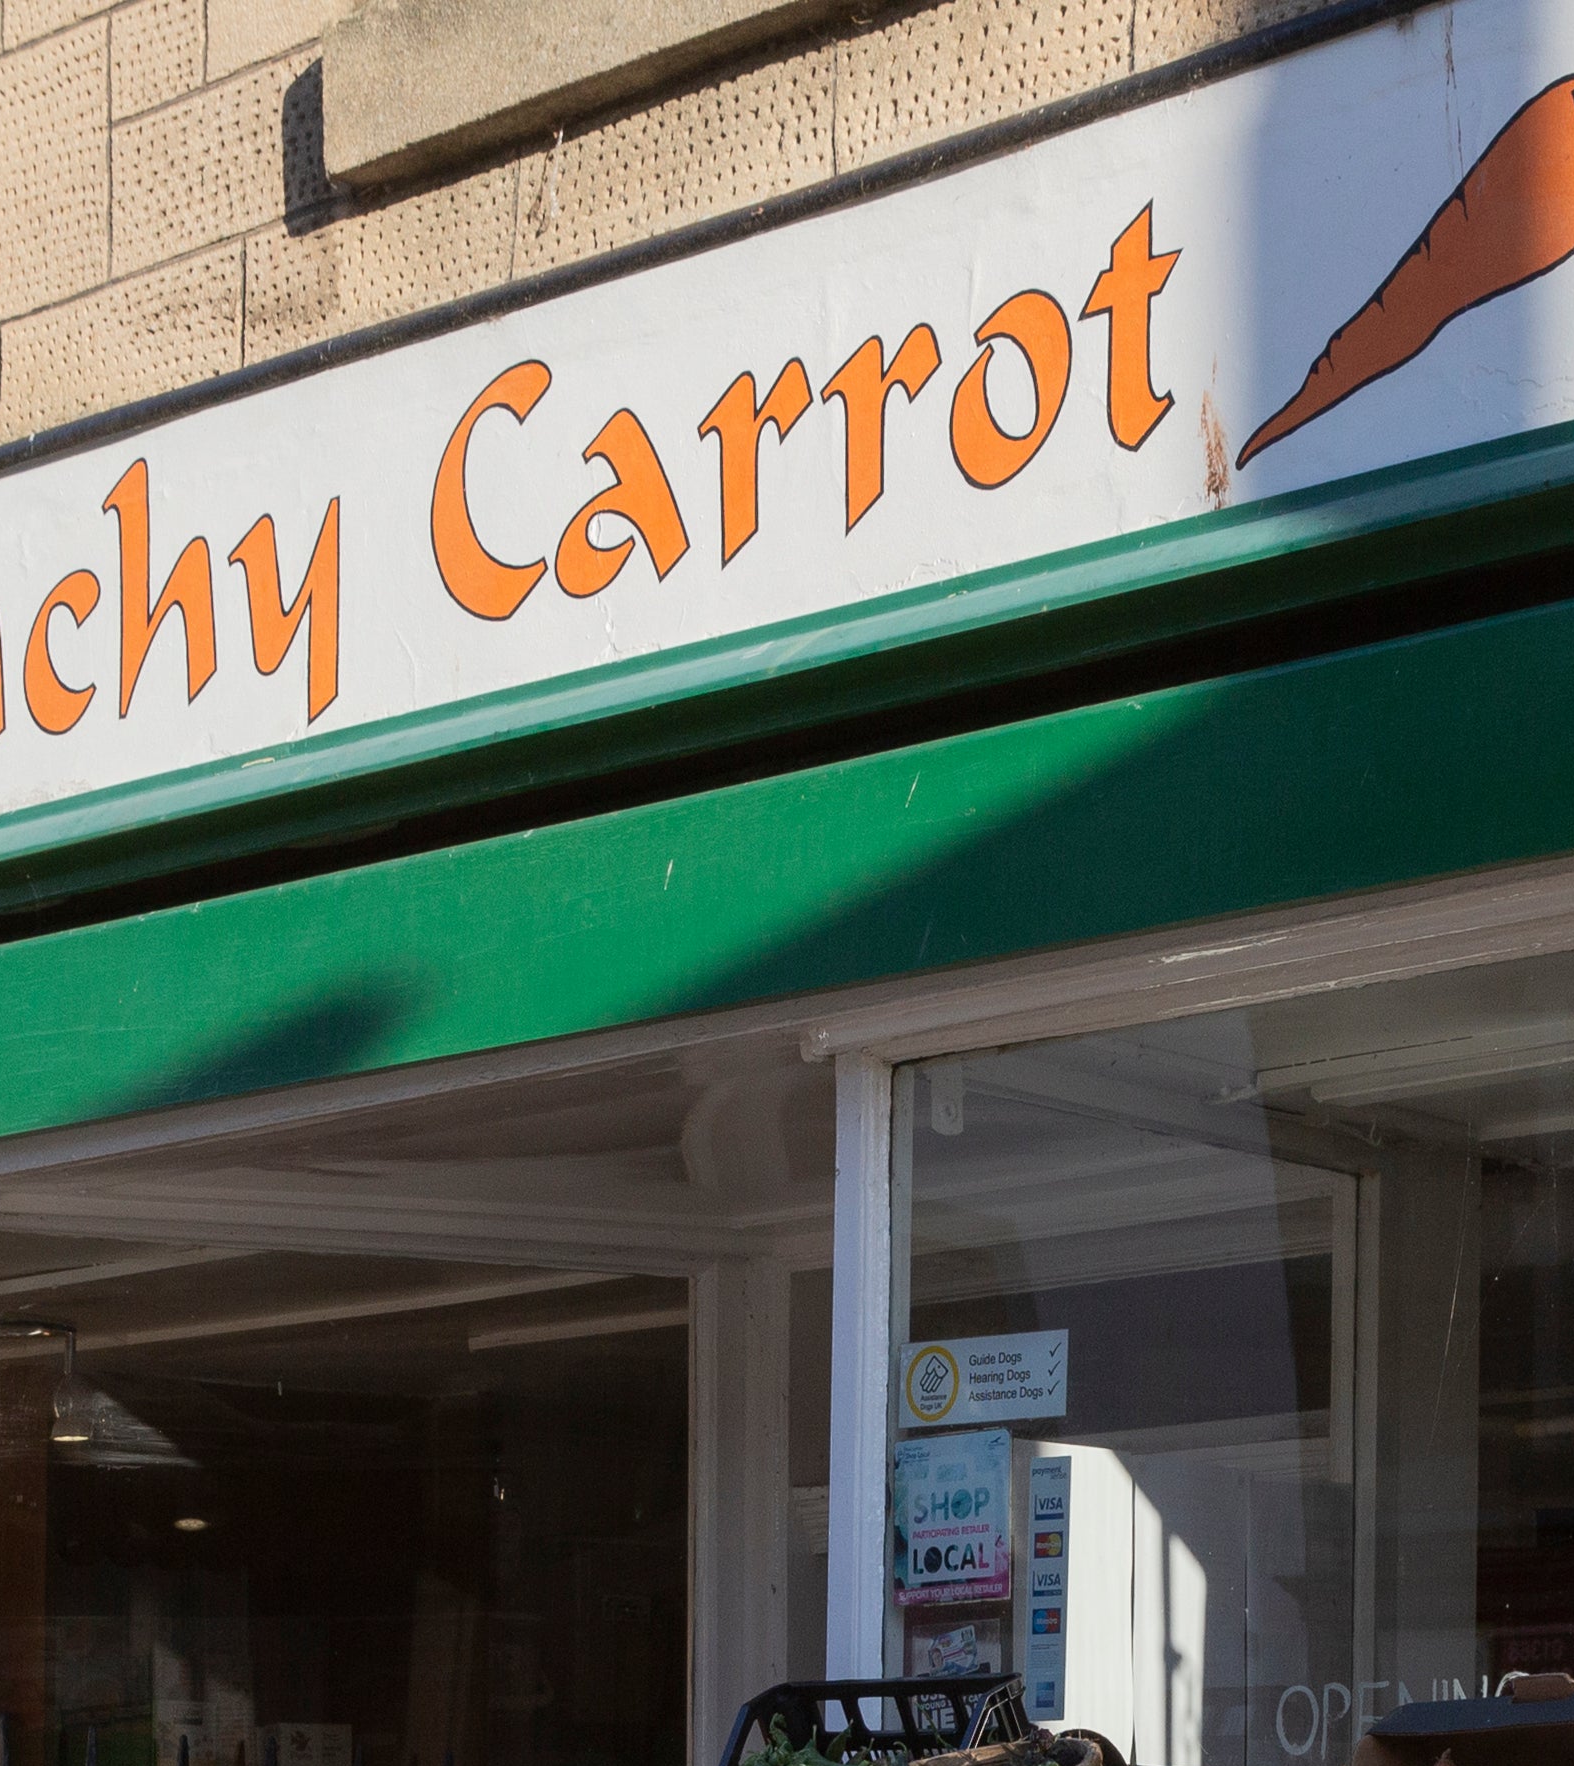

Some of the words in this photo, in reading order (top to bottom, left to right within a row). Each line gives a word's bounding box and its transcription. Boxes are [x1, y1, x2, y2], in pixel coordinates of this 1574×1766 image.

[429, 199, 1183, 621] Carrot
[969, 1354, 995, 1366] Guide
[998, 1352, 1022, 1365] Dogs
[969, 1372, 1004, 1384] Hearing
[1007, 1370, 1031, 1383] Dogs
[969, 1389, 1016, 1401] Assistance
[1020, 1386, 1044, 1399] Dogs
[914, 1487, 990, 1524] SHOP
[1039, 1497, 1063, 1510] VISA
[913, 1527, 960, 1539] PARTICIPATING
[961, 1524, 990, 1534] RETAILER
[913, 1543, 989, 1574] LOCAL
[1037, 1573, 1060, 1586] VISA
[899, 1589, 929, 1600] SUPPORT
[930, 1588, 951, 1598] YOUR
[952, 1586, 973, 1595] LOCAL
[975, 1584, 1003, 1594] RETAILER
